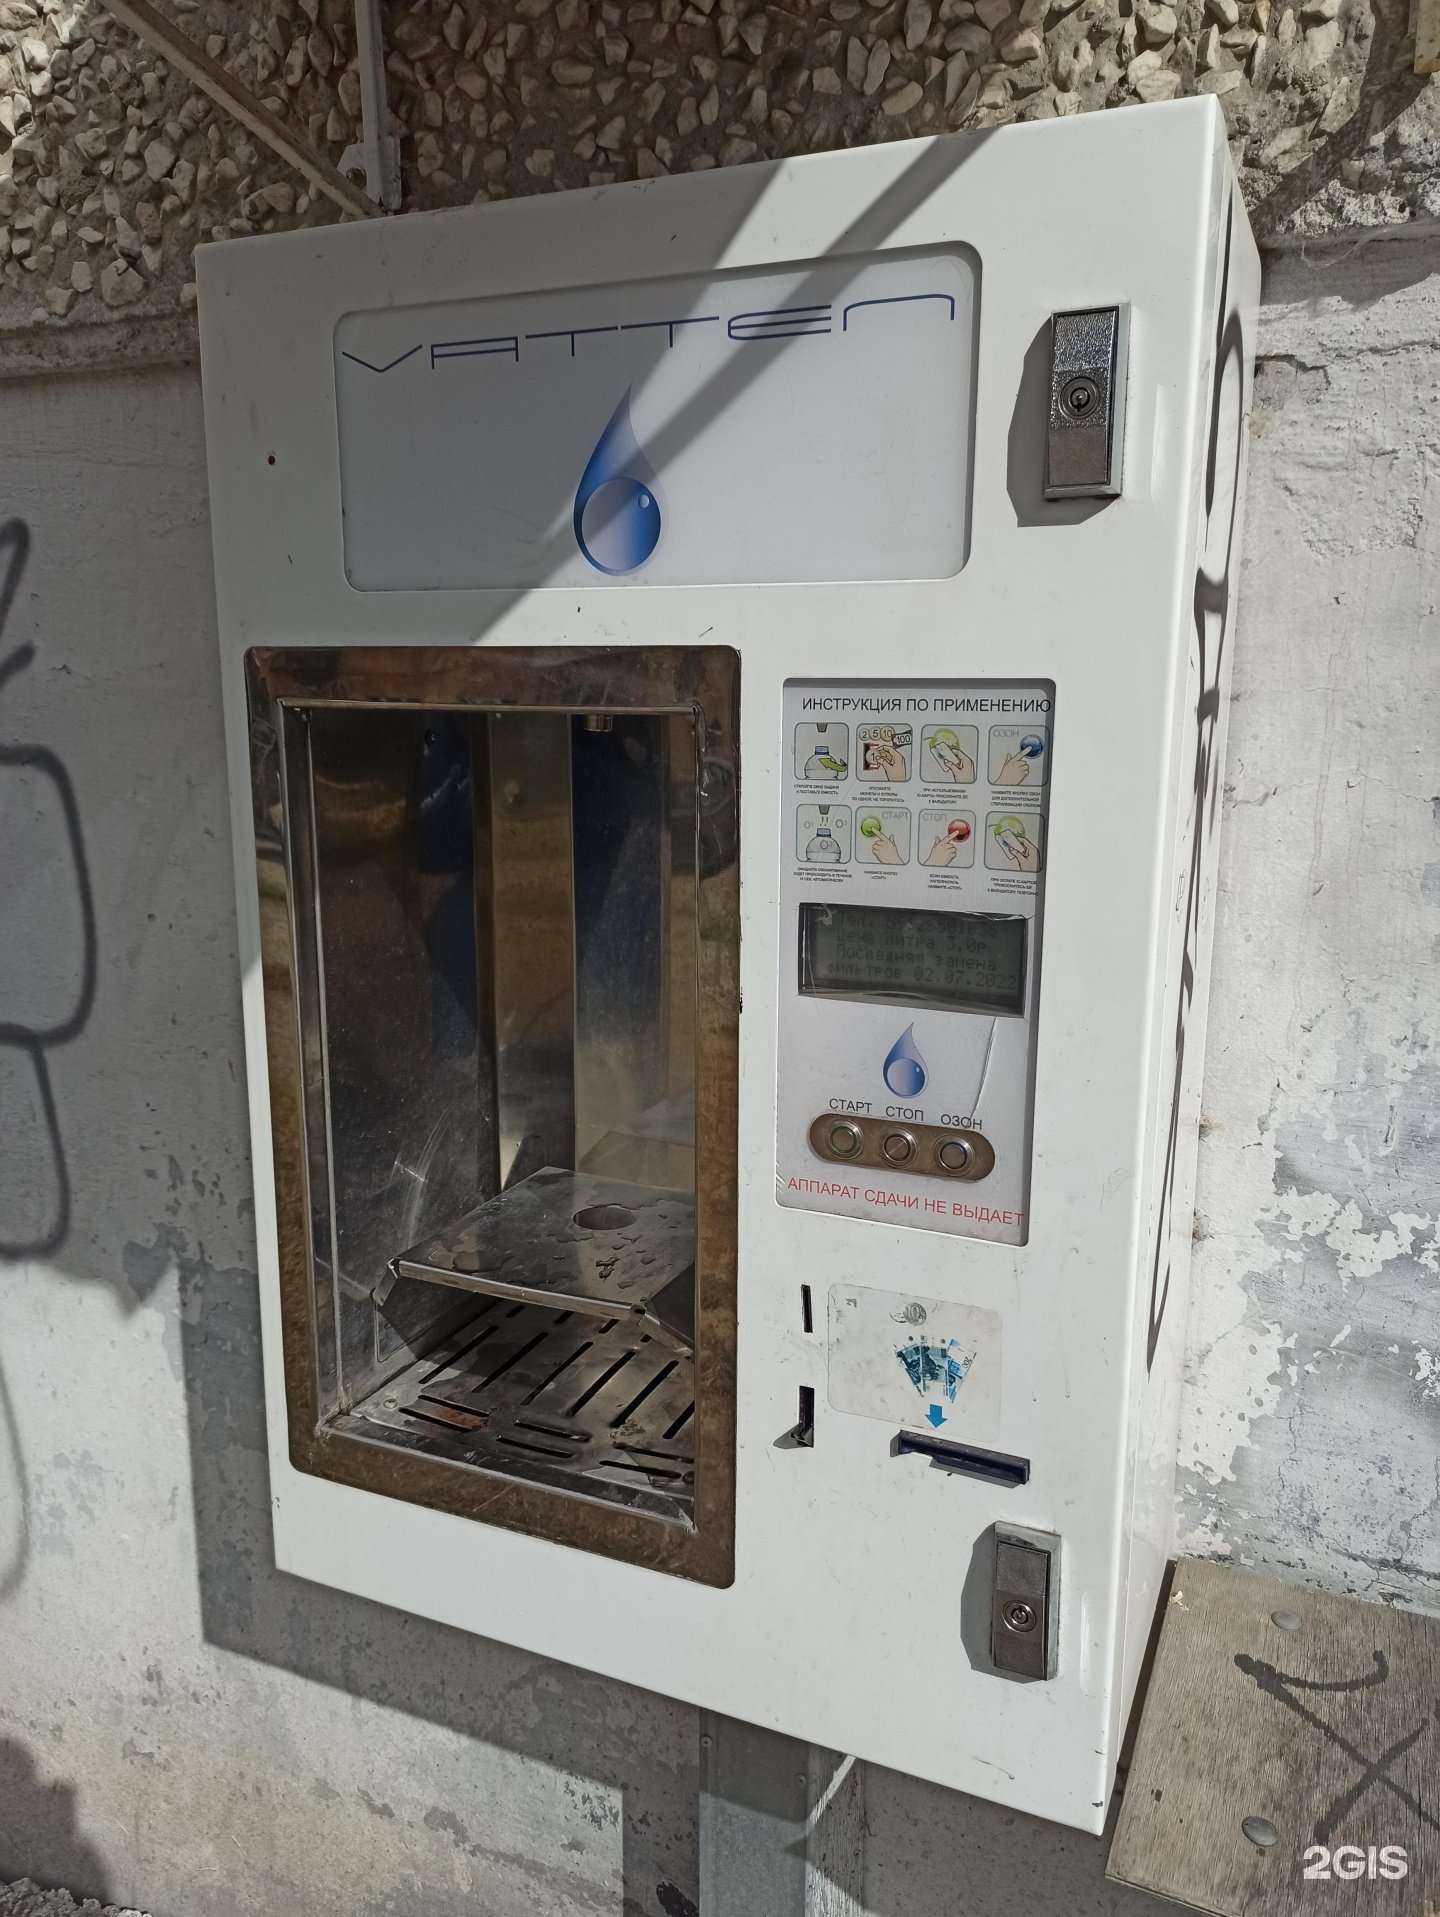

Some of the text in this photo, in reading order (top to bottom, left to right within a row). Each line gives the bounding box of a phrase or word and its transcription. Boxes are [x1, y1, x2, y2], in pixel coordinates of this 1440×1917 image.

[802, 697, 1051, 714] ИНСТРУКЦИЯ ПО ПРИМЕНЕНИЮ
[935, 954, 997, 972] замена
[828, 1098, 873, 1115] СТАРТ
[885, 1106, 924, 1121] СТОП
[940, 1113, 983, 1130] ОЗОН
[787, 1177, 1025, 1226] АППАРАТ СДАЧИ НЕ ВЫДАЕТ
